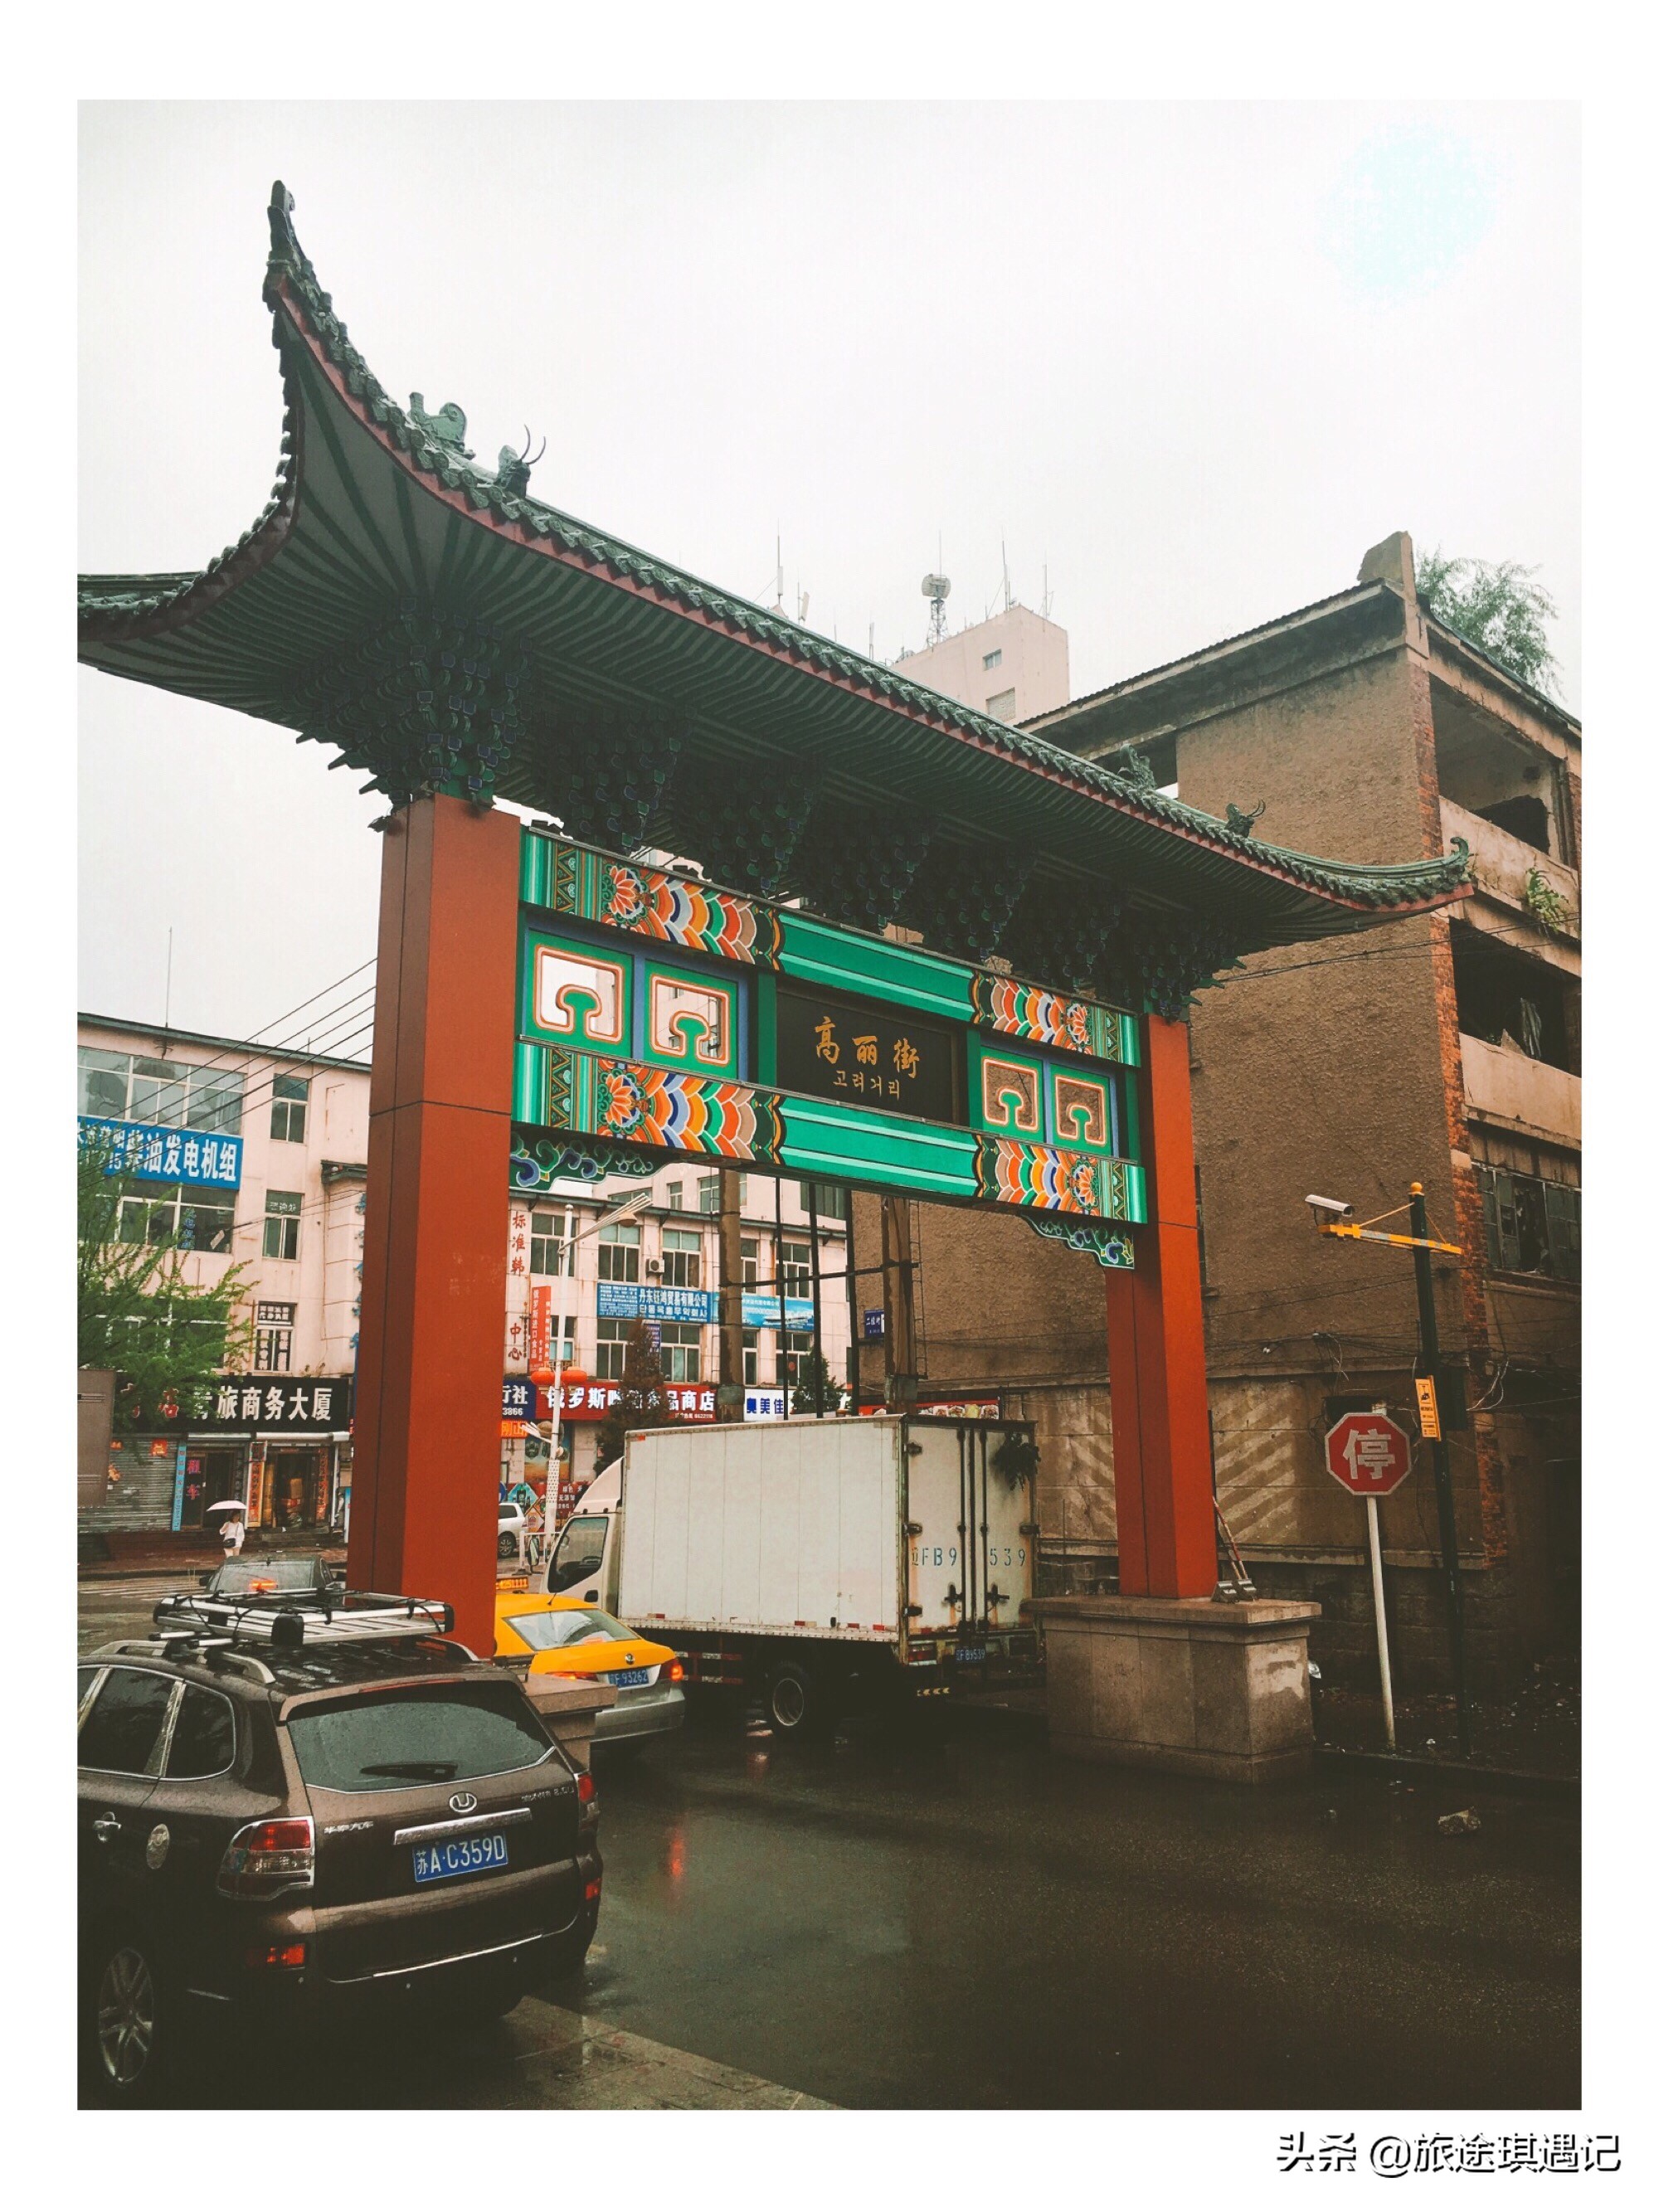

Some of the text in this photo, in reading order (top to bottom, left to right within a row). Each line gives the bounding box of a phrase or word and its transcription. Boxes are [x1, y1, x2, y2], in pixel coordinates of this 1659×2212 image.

[815, 1016, 920, 1078] 高丽街
[833, 1070, 900, 1101] 고려거리
[127, 1130, 238, 1182] 柴油发电机组
[508, 1322, 523, 1360] 中心
[1342, 1428, 1396, 1480] 停
